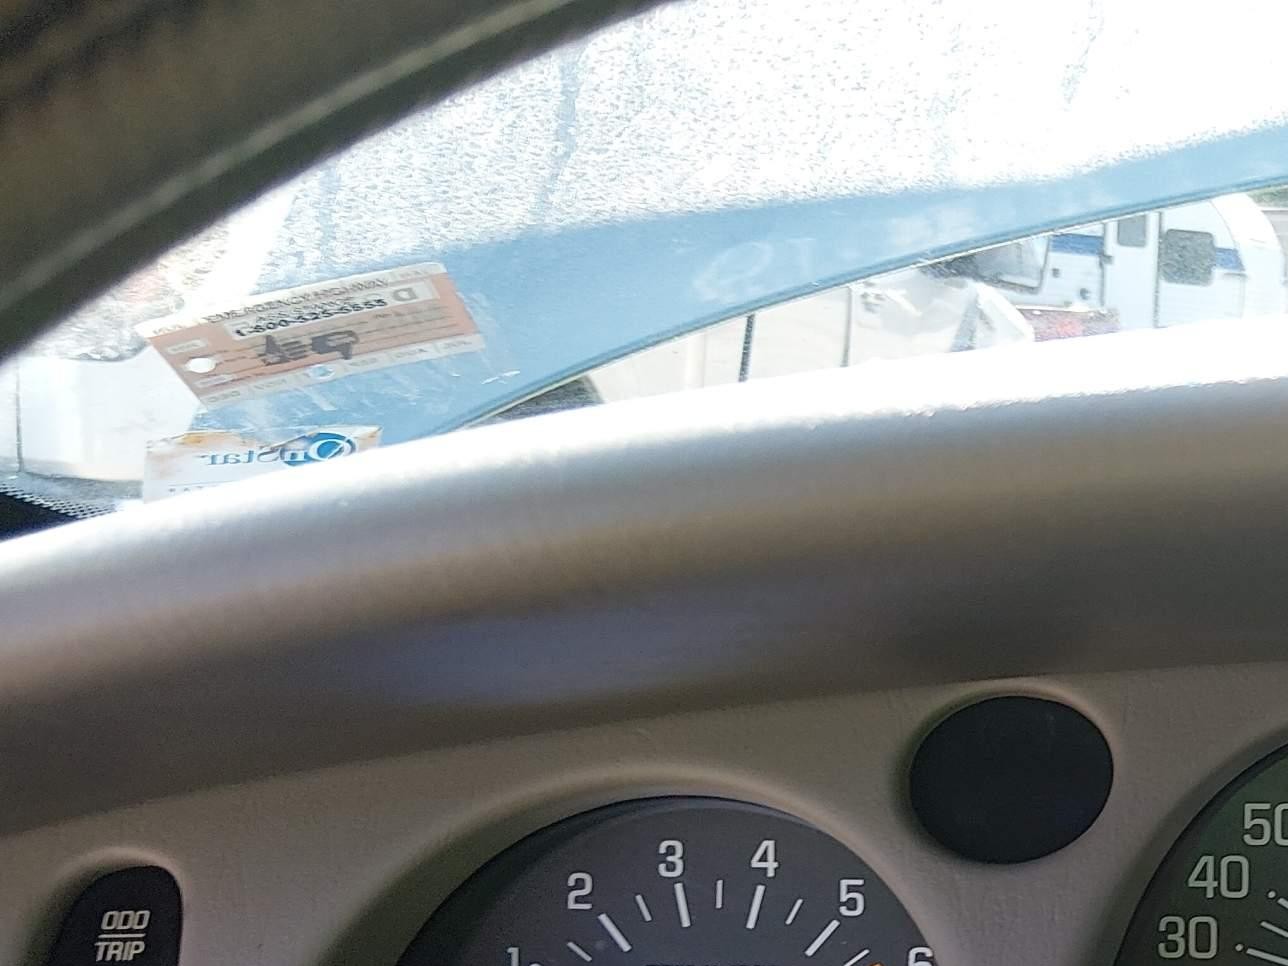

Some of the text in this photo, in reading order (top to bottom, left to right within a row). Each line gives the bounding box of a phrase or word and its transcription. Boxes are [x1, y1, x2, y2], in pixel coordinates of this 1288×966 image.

[659, 840, 683, 877] 3
[751, 841, 778, 877] 4
[568, 873, 592, 909] 2
[1189, 856, 1249, 898] 40
[840, 880, 864, 916] 5
[101, 910, 150, 929] ODO
[1159, 916, 1217, 958] 30
[96, 941, 145, 961] TRIP
